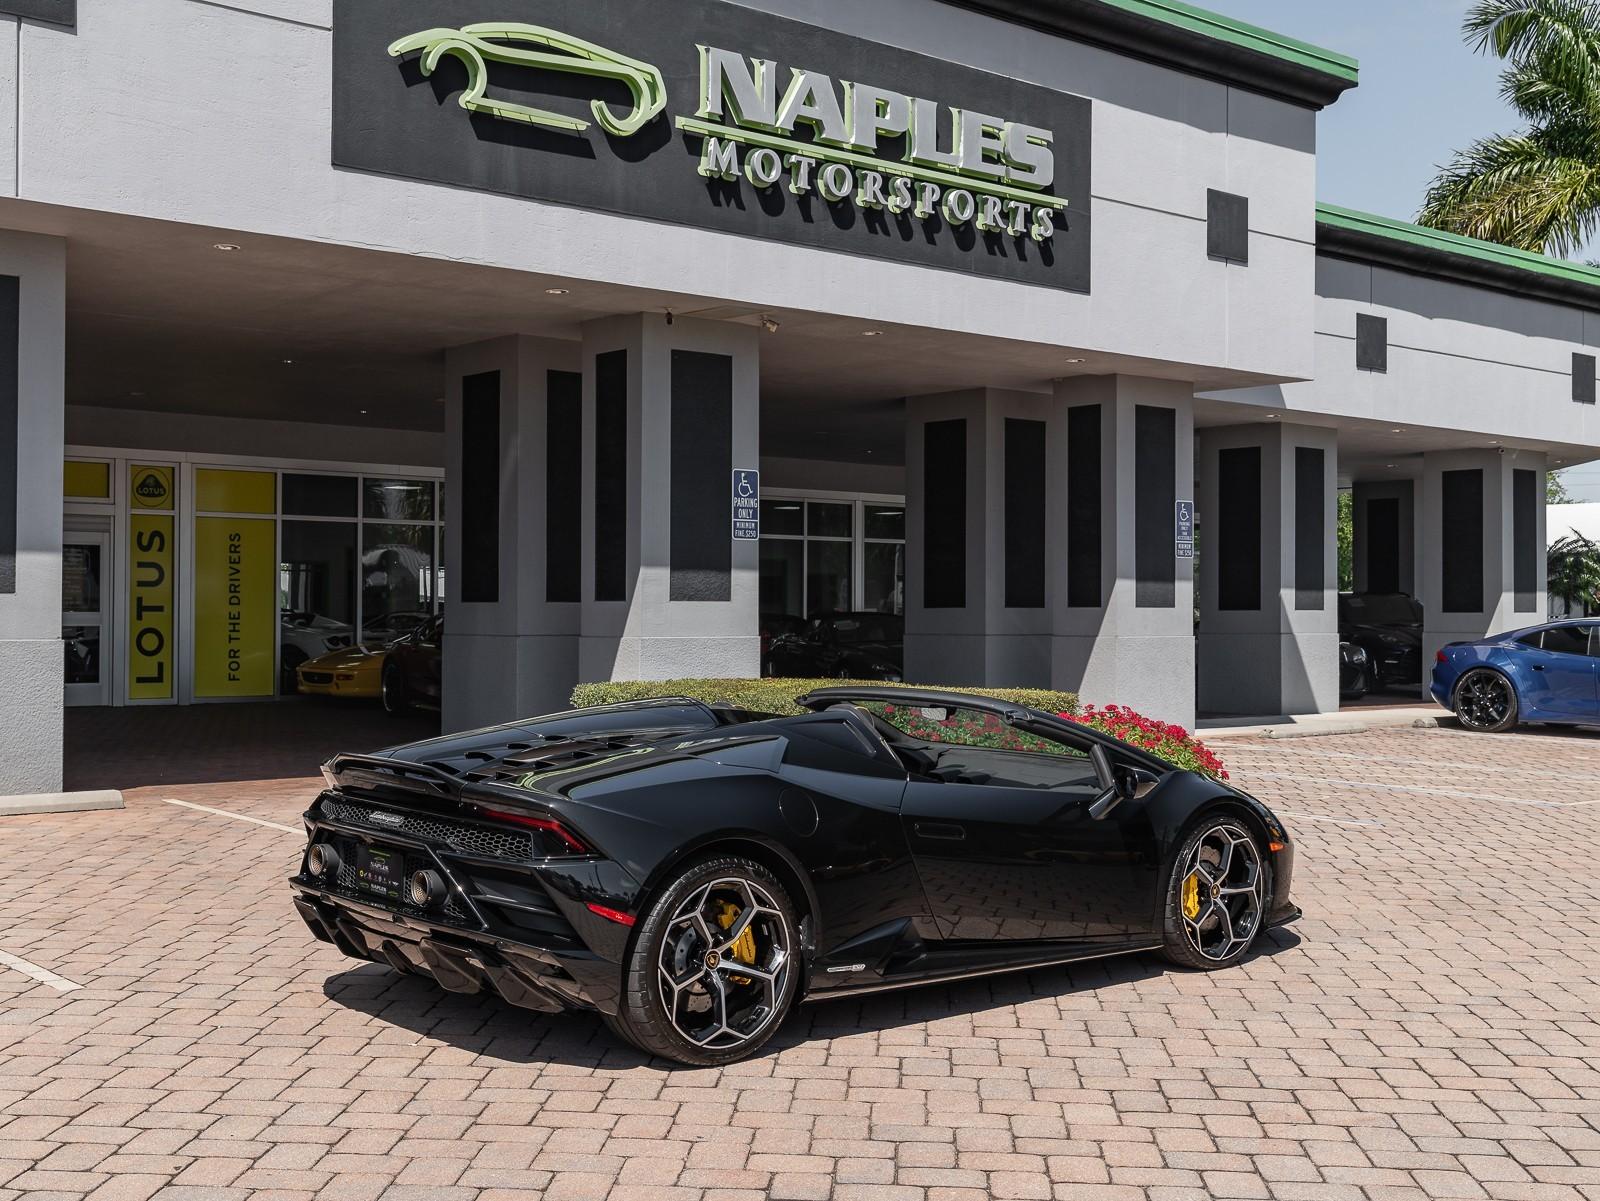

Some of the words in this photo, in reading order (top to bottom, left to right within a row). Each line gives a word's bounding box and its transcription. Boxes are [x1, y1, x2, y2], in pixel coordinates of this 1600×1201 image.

[695, 43, 1055, 189] NAPLES
[697, 136, 1055, 242] MOTORSPORTS
[138, 487, 165, 495] LOTUS
[733, 497, 758, 508] PARKING
[738, 509, 753, 518] ONLY
[228, 532, 241, 606] DRIVERS
[136, 530, 165, 684] LOTUS
[228, 611, 241, 644] THE
[228, 648, 241, 681] FOR
